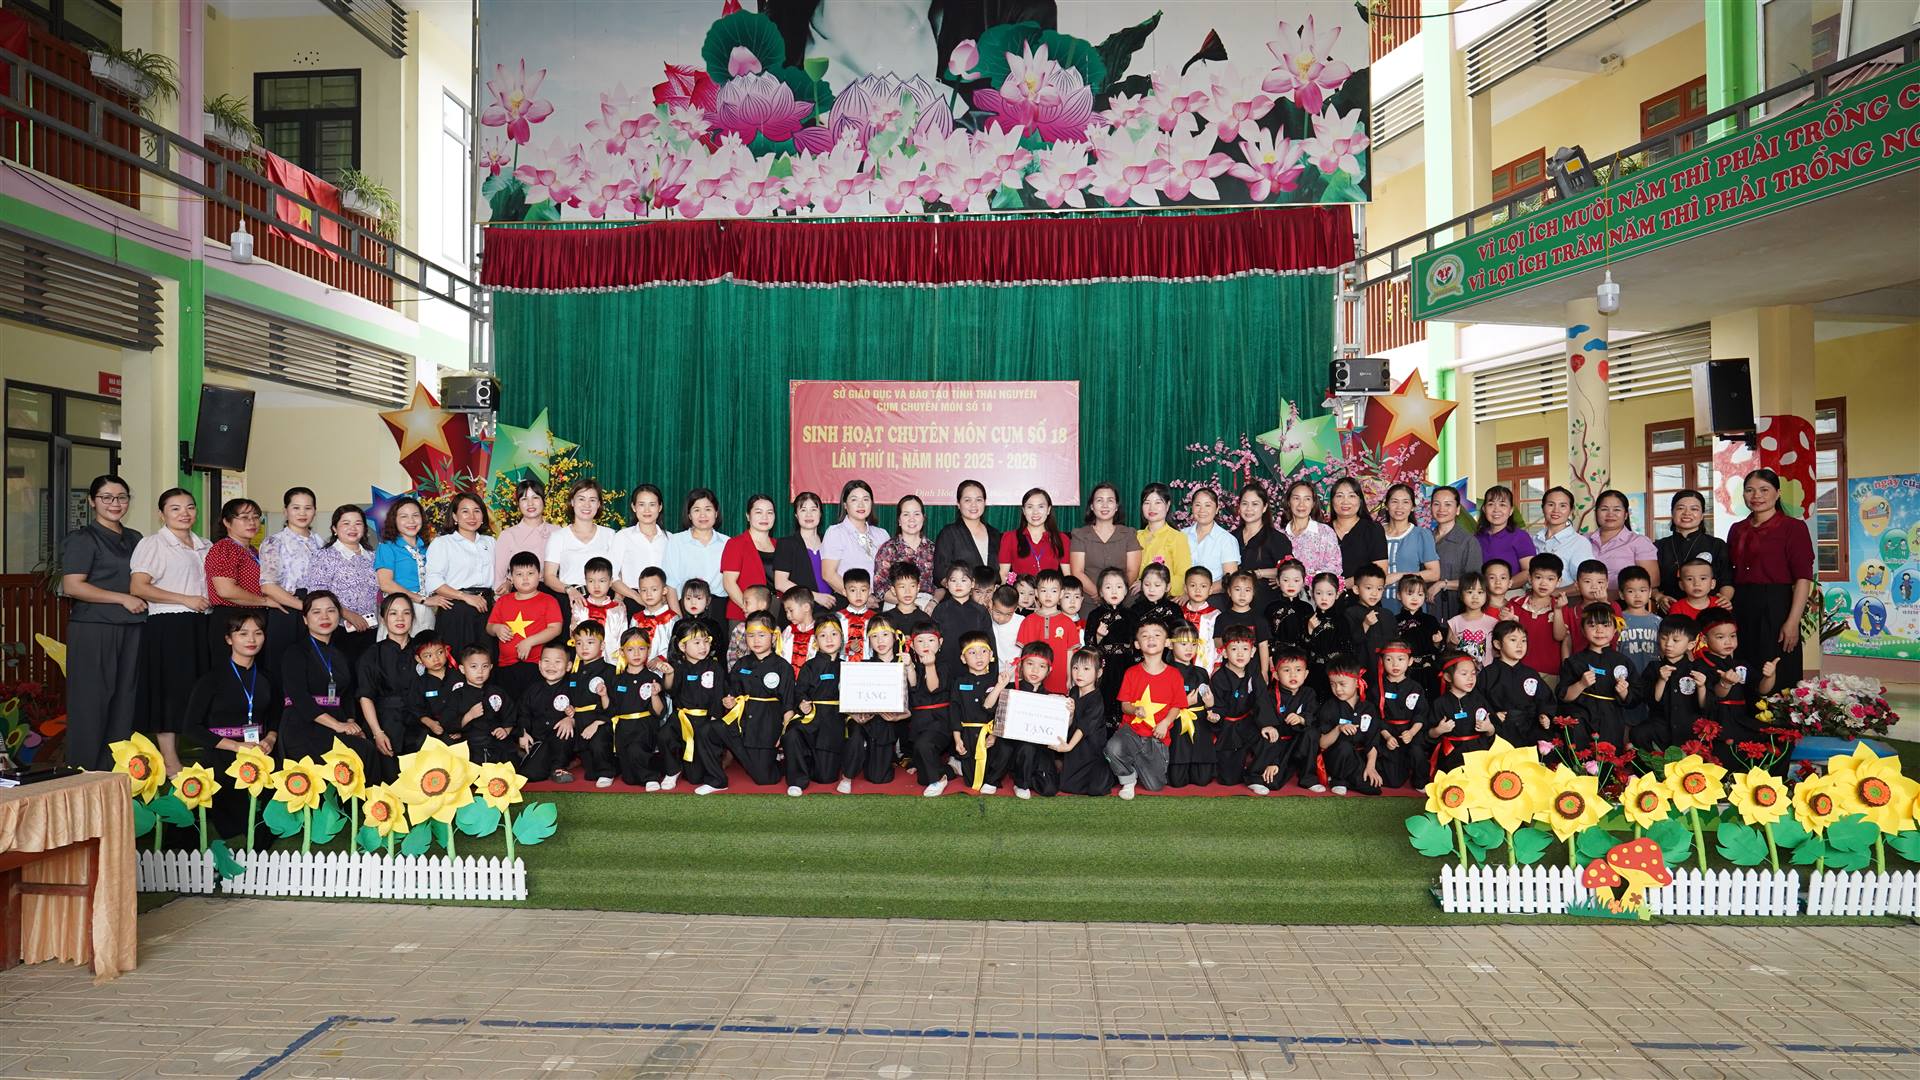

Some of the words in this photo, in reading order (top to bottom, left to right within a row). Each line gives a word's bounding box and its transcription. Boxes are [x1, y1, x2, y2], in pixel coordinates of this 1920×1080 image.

[1478, 238, 1495, 260] VÌ
[1498, 231, 1524, 254] LỢI
[1528, 223, 1559, 244] ÍCH
[1562, 197, 1614, 232] MƯỜI
[1617, 180, 1666, 212] NĂM
[1670, 157, 1711, 192] THÌ
[1716, 134, 1780, 177] PHẢI
[1785, 100, 1890, 151] TRỒNG
[1468, 269, 1485, 291] VÌ
[1488, 263, 1515, 286] LỢI
[1518, 255, 1547, 276] ÍCH
[1551, 233, 1605, 265] TRĂM
[1608, 215, 1656, 247] NĂM
[1660, 195, 1700, 229] THÌ
[1704, 175, 1767, 216] PHẢI
[1771, 145, 1875, 193] TRỒNG
[876, 402, 898, 414] CỤM
[901, 401, 938, 412] CHUYÊN
[941, 401, 962, 412] MÔN
[965, 400, 978, 412] SỐ
[895, 387, 906, 399] VÀ
[931, 389, 949, 401] TẠO
[999, 387, 1037, 399] NGUYÊN
[802, 425, 839, 443] SINH
[842, 425, 884, 448] HOẠT
[887, 421, 949, 443] CHUYÊN
[953, 421, 986, 443] MÔN
[991, 426, 1024, 448] CỤM
[1027, 418, 1047, 443] SỐ
[1052, 427, 1067, 443] 18
[832, 446, 856, 468] LẦN
[860, 449, 884, 469] THỨ
[887, 452, 899, 470] II,
[902, 449, 930, 469] NĂM
[935, 452, 960, 472] HỌC
[964, 452, 994, 469] 2025
[1007, 452, 1037, 469] 2026
